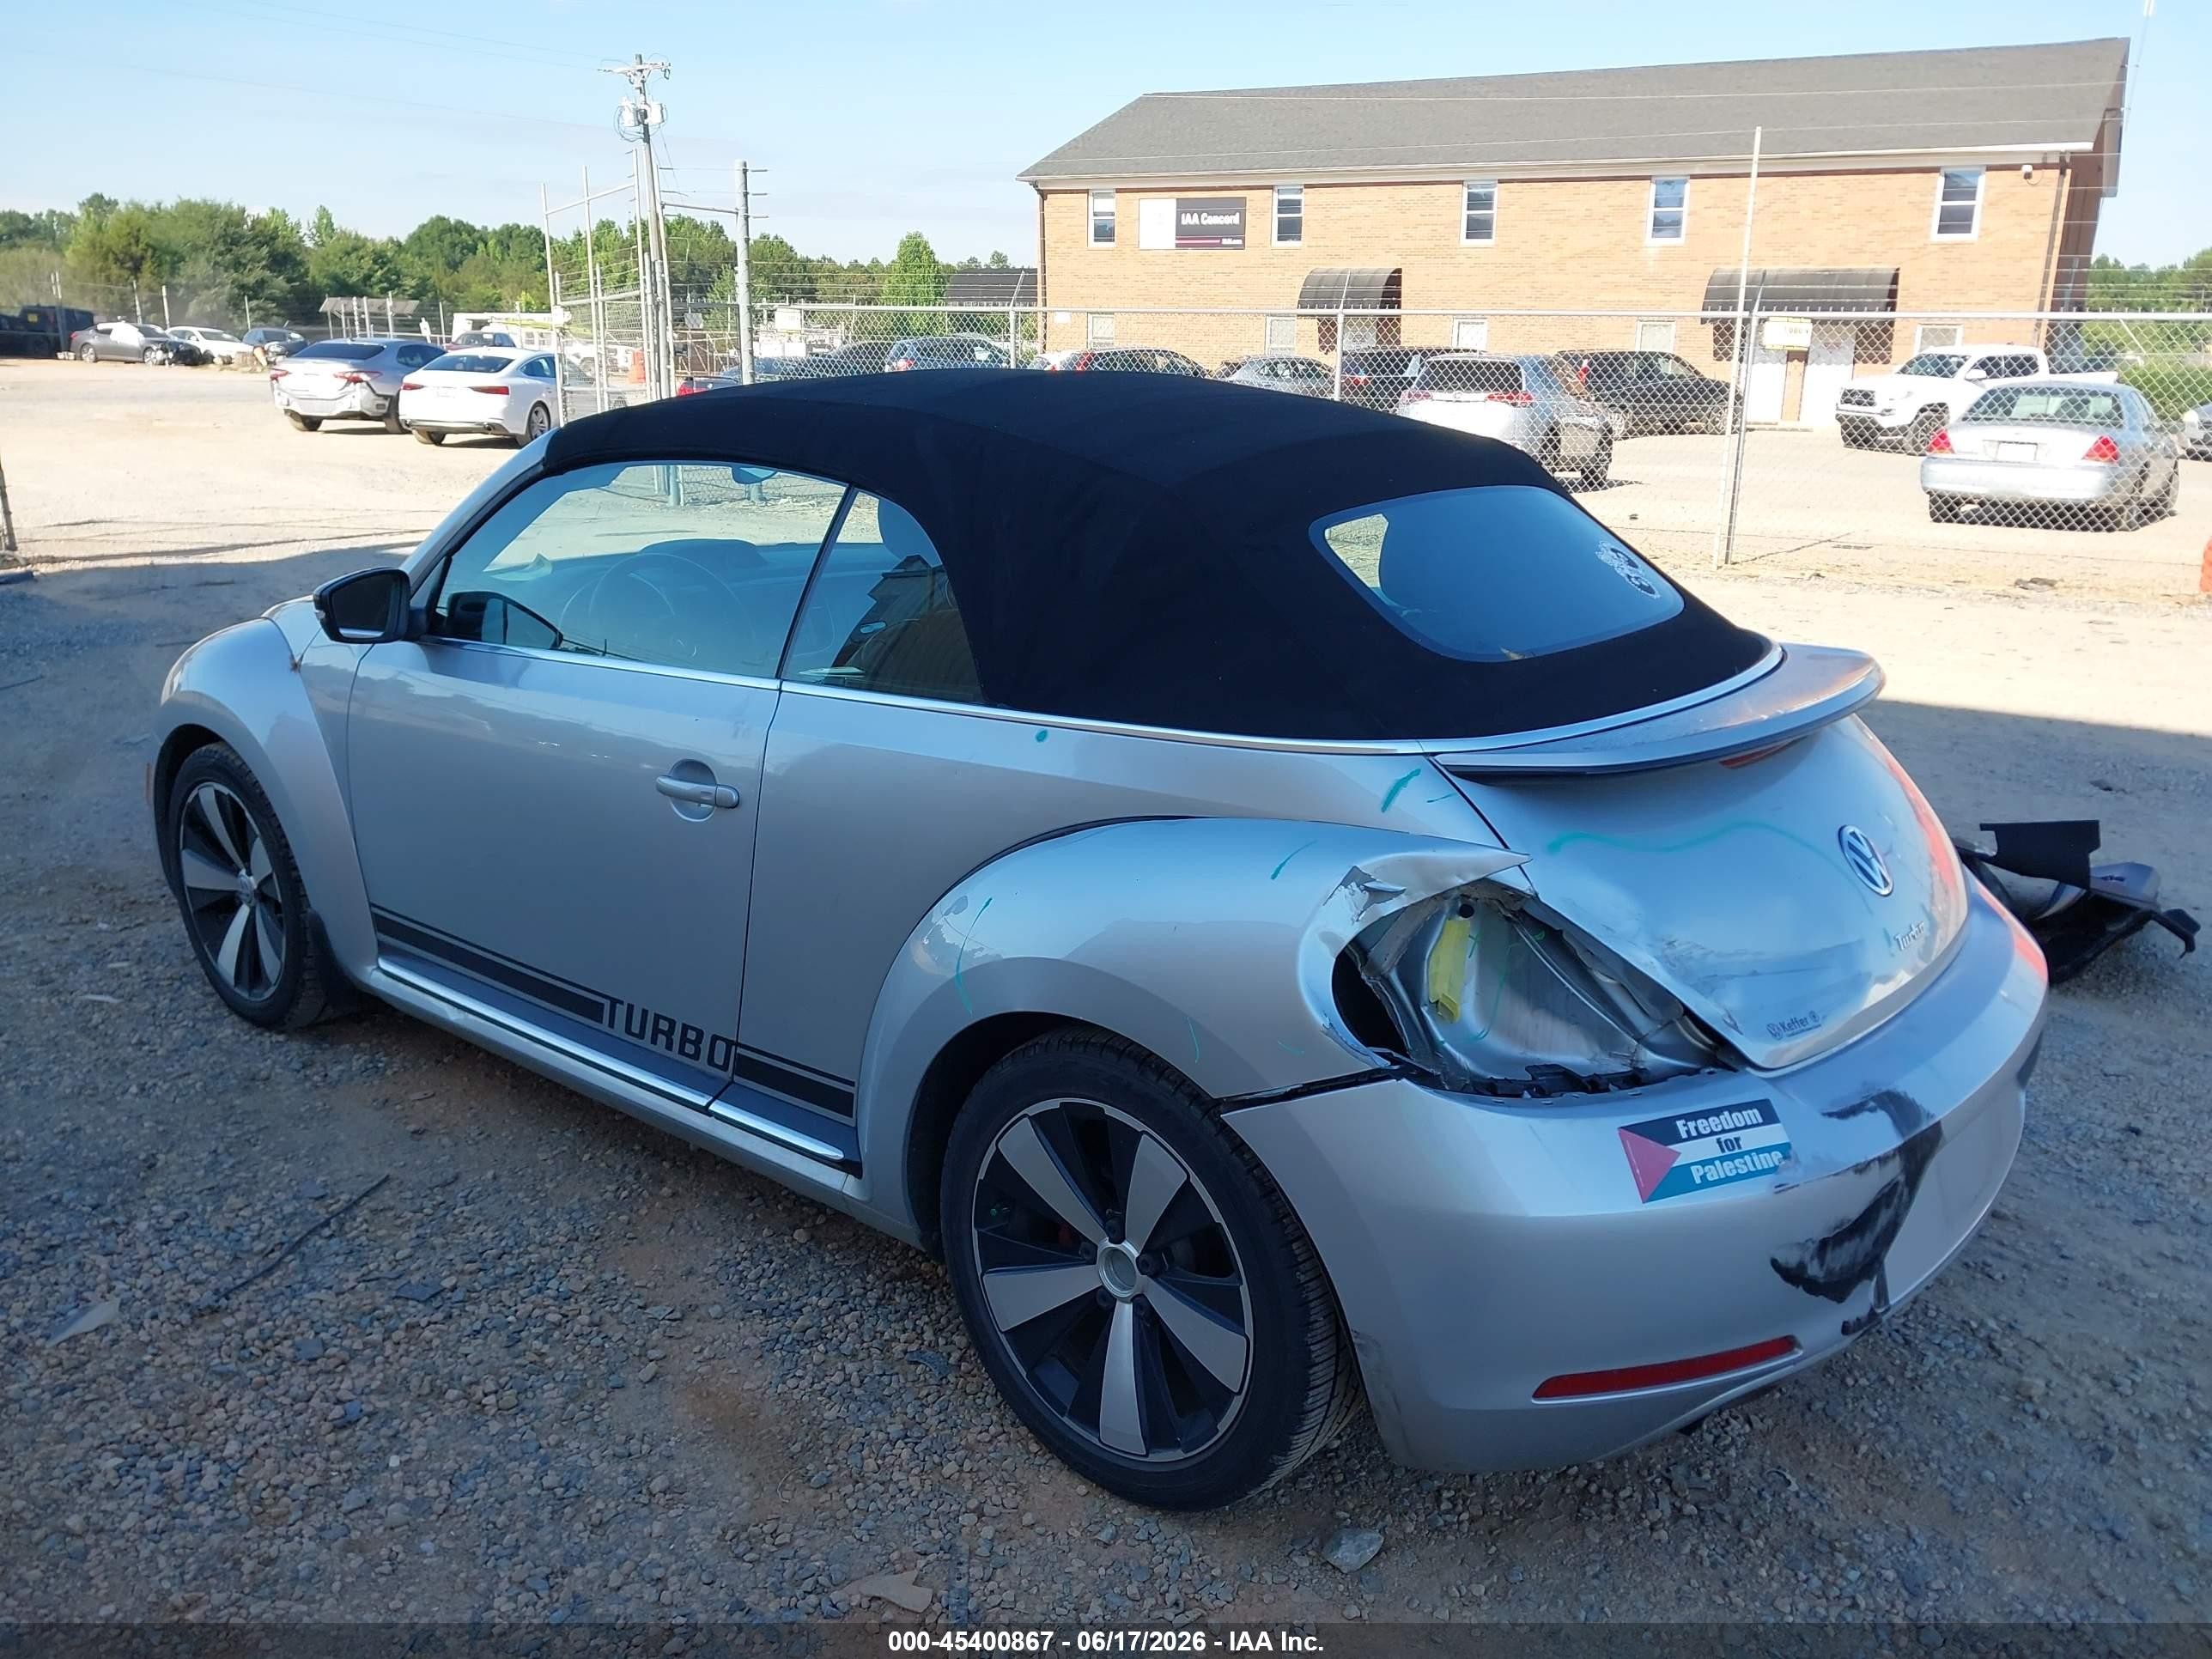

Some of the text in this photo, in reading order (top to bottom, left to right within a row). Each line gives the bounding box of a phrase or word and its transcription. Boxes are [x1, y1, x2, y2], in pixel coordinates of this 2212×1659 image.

[1181, 211, 1240, 225] IAA Concord
[605, 997, 733, 1073] TURBO
[1675, 1107, 1763, 1139] Freedom
[1716, 1136, 1743, 1154] for
[1690, 1150, 1784, 1185] Palestine
